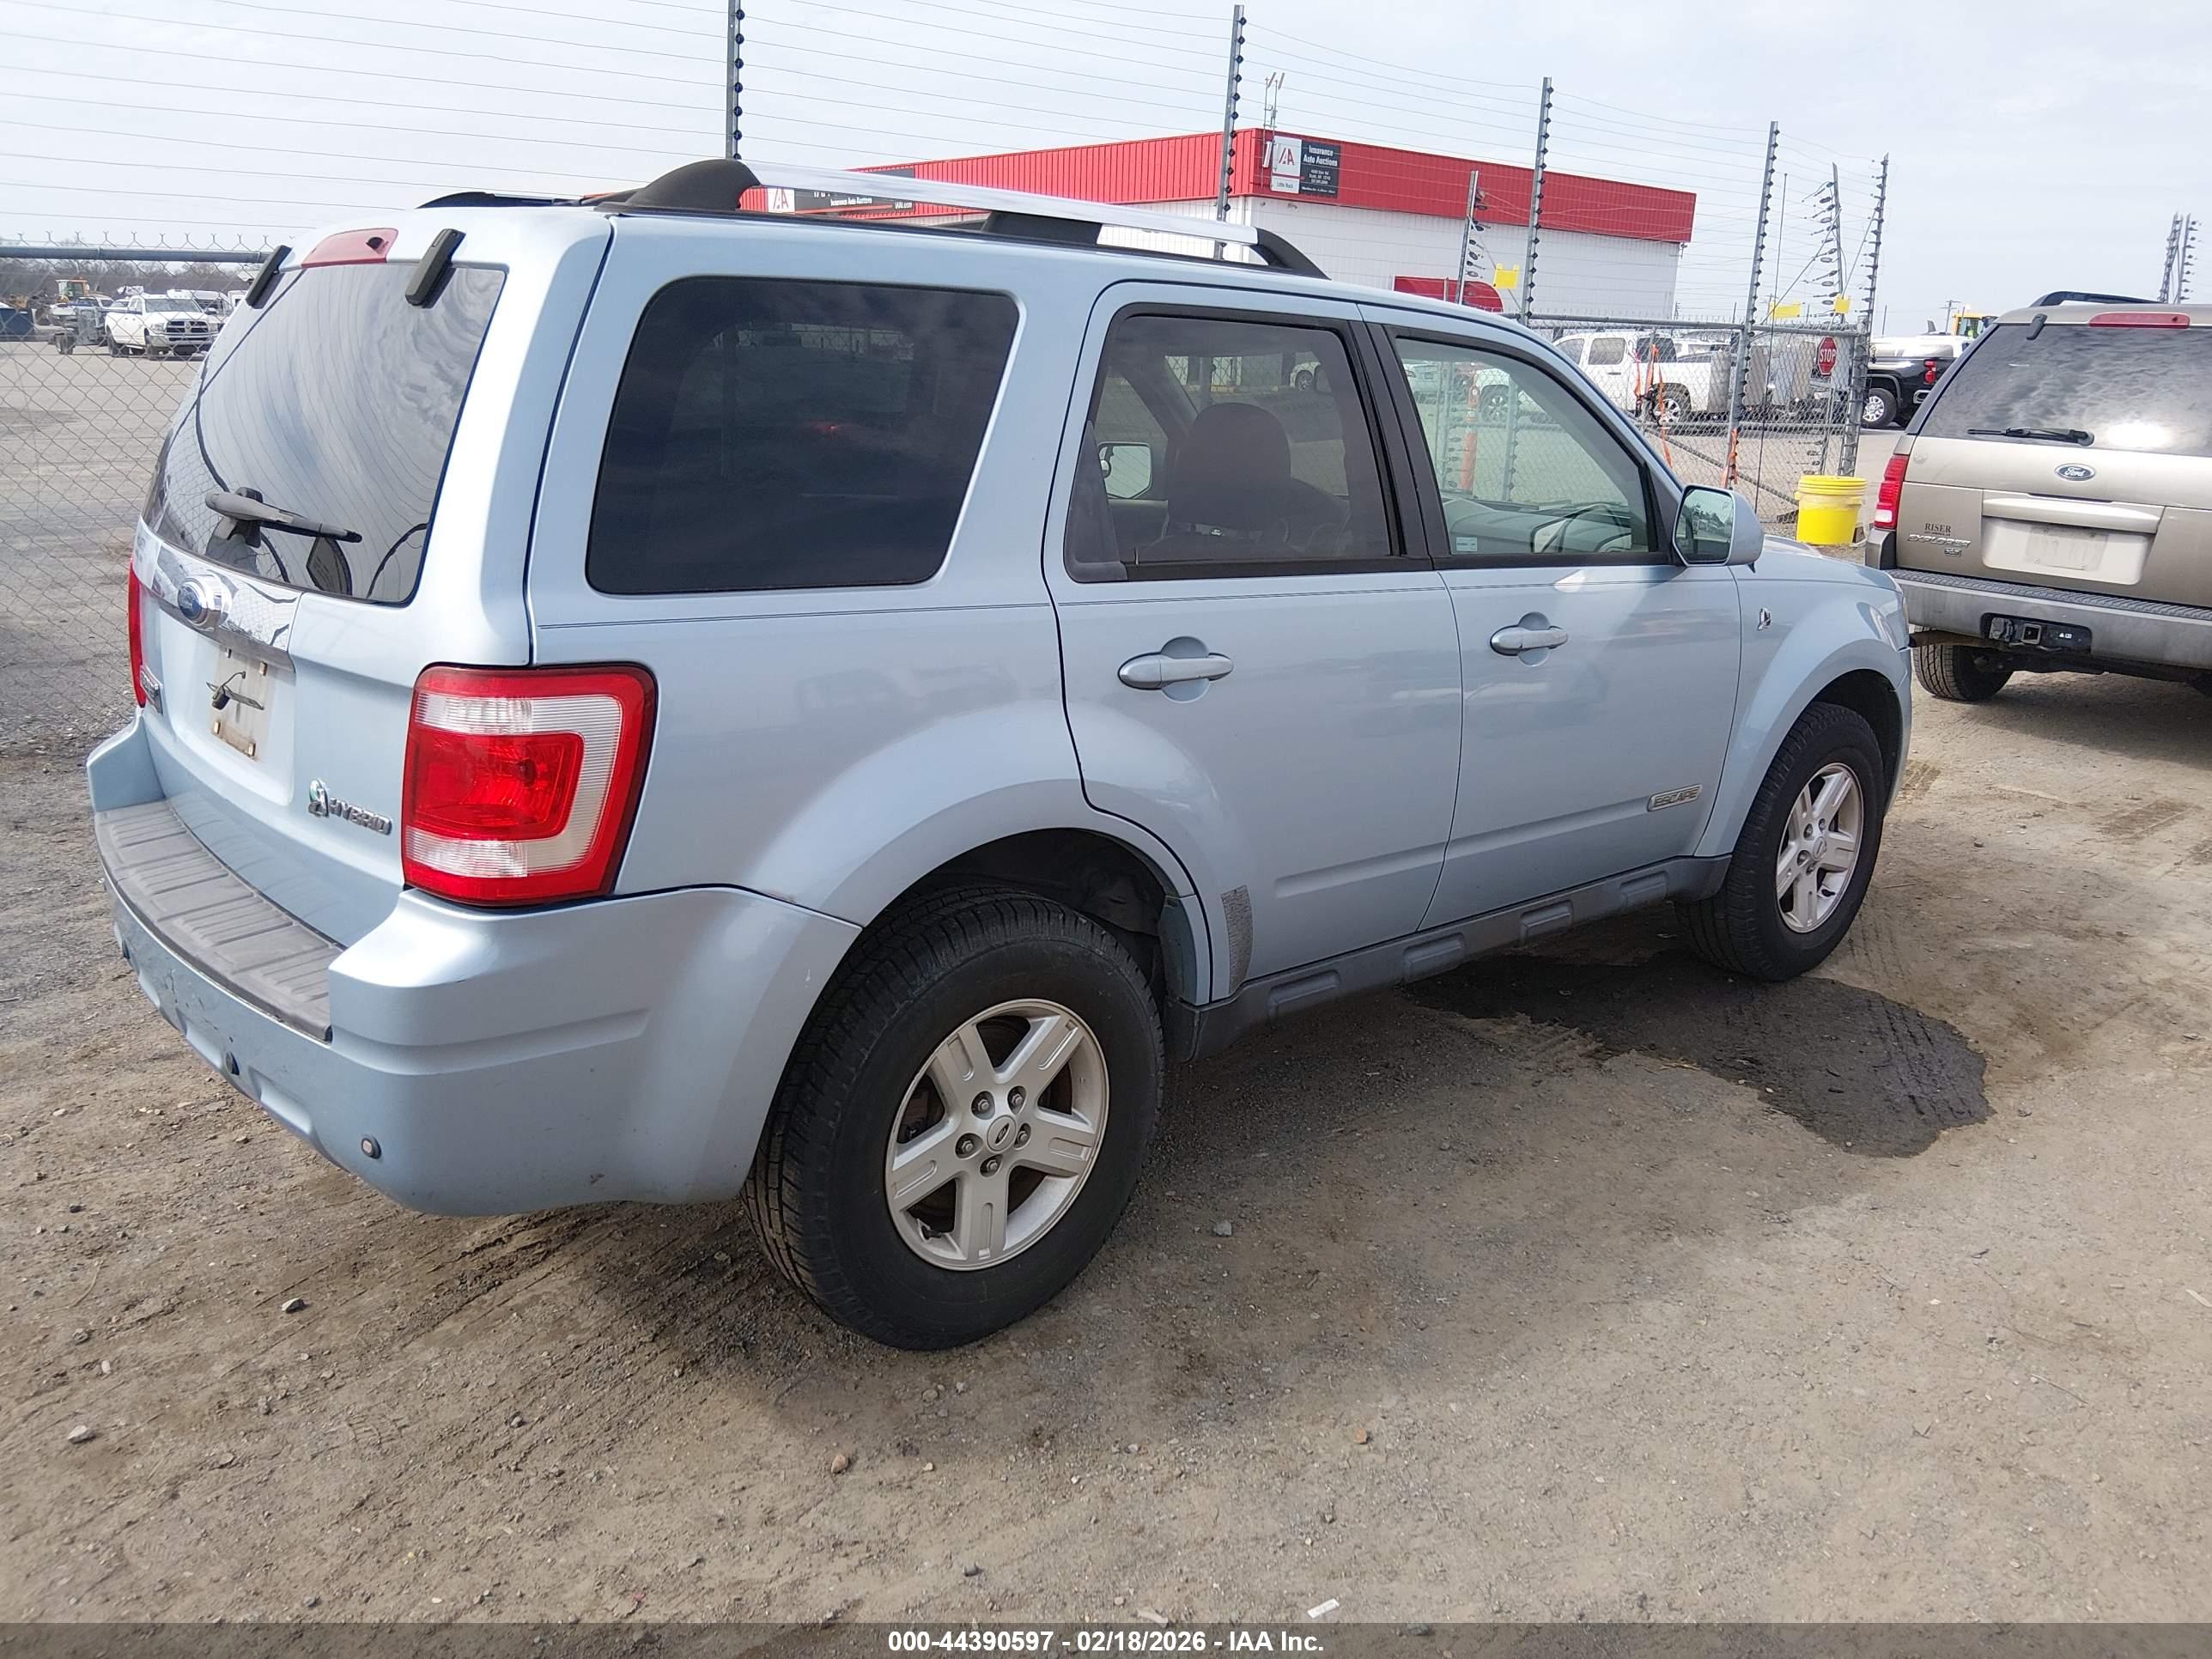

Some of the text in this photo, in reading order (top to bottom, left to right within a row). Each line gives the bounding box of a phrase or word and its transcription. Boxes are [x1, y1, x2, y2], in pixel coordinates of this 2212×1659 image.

[1309, 145, 1334, 155] Insurance
[1304, 155, 1337, 166] Auto Auctions
[1820, 349, 1836, 362] STOP
[1924, 522, 1952, 533] RISER
[1655, 787, 1698, 806] ESCAPE
